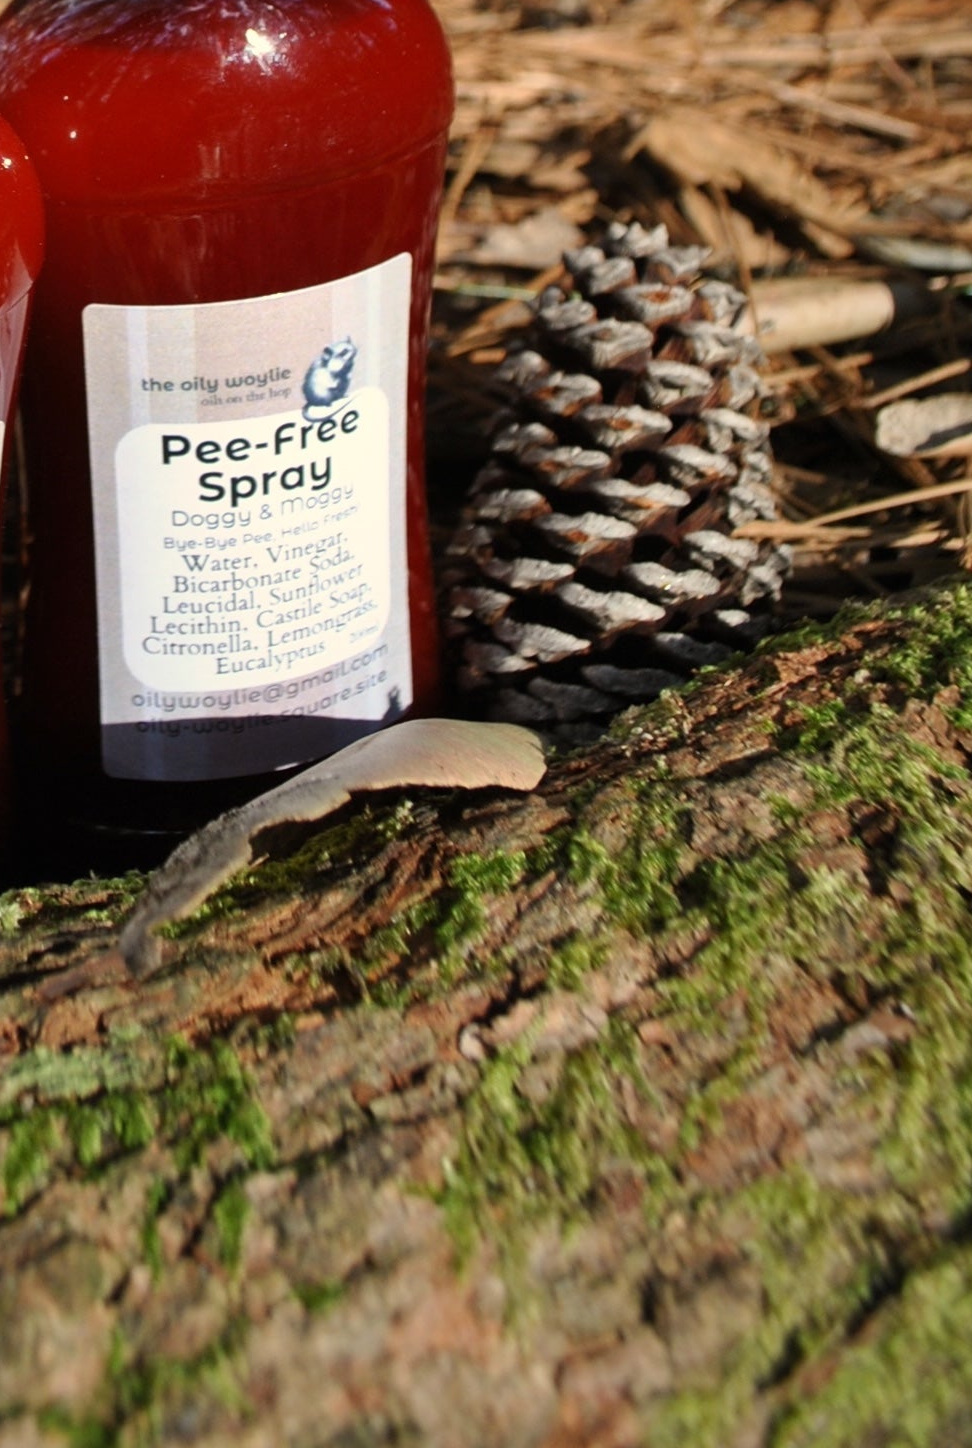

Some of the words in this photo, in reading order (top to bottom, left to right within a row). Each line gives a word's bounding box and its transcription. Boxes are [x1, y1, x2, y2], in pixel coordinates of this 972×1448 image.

[141, 377, 175, 393] the
[180, 376, 219, 394] oily
[225, 367, 291, 391] woylie
[161, 409, 359, 465] Pee-Free
[198, 456, 331, 507] Spray
[171, 509, 251, 530] Doggy
[259, 503, 273, 520] &
[162, 536, 237, 552] Bye-Bye
[173, 566, 301, 594] Bicarbonate
[269, 563, 364, 607] Sunflower
[256, 599, 322, 630] Castile
[215, 641, 326, 675] Eucalyptus
[131, 641, 390, 713] oilywoylie@gmail.com
